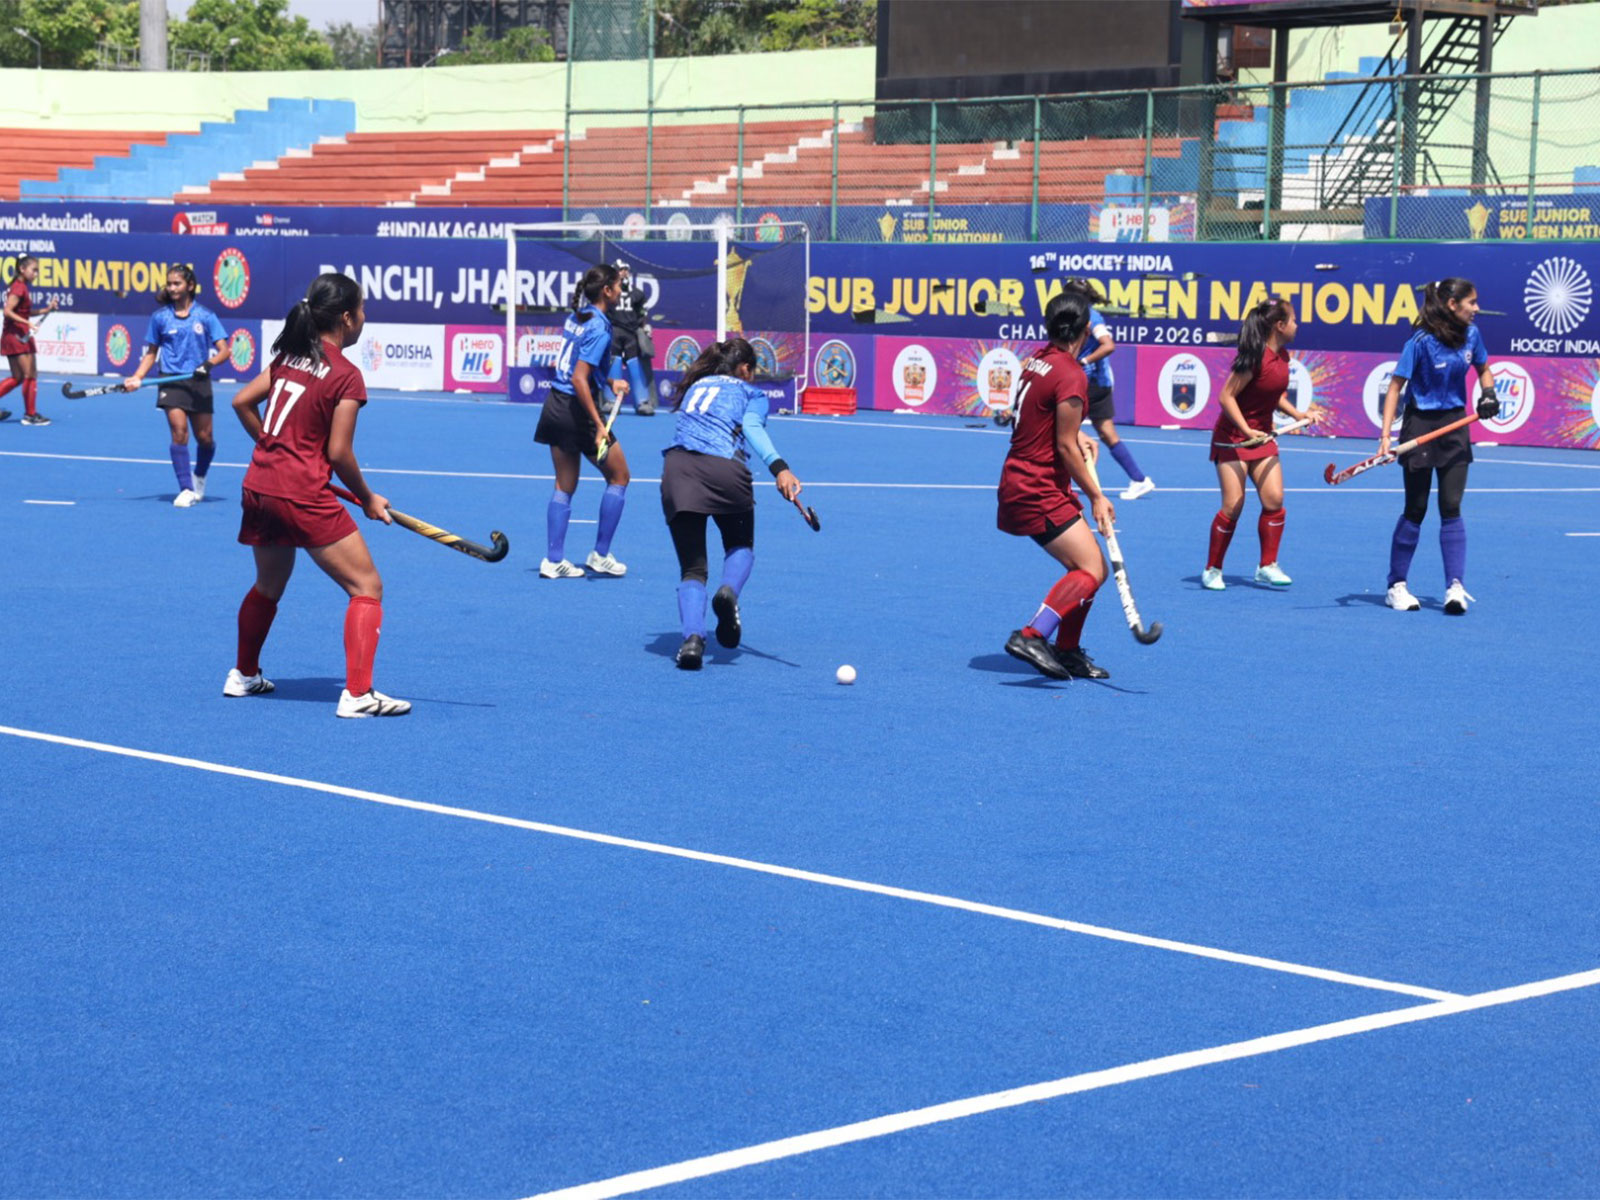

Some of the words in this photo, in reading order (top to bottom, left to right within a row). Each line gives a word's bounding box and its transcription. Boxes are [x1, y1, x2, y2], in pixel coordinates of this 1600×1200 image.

[190, 214, 214, 222] WATCH
[1127, 214, 1157, 226] Heo
[1500, 209, 1528, 222] SUB
[1533, 208, 1590, 222] JUNIOR
[903, 219, 925, 230] SUB
[928, 218, 968, 230] UNIOR
[1562, 224, 1600, 239] NATI
[29, 240, 56, 253] INDIA
[1059, 255, 1123, 271] HOCKEY
[1128, 255, 1173, 271] INDIA
[0, 256, 69, 289] OEN
[75, 258, 202, 294] NATION
[319, 264, 443, 309] NCHI,
[451, 267, 660, 311] JHARKHD
[806, 276, 876, 314] SUB
[884, 277, 1025, 317] JUNIOR
[1210, 280, 1421, 325] NATIONA
[1154, 326, 1203, 344] 2026
[385, 344, 433, 360] ODISHA
[471, 339, 495, 350] Hero
[1511, 338, 1563, 353] HOCKEY
[1565, 339, 1600, 354] INDIA
[263, 378, 306, 437] 17
[686, 386, 720, 415] 11
